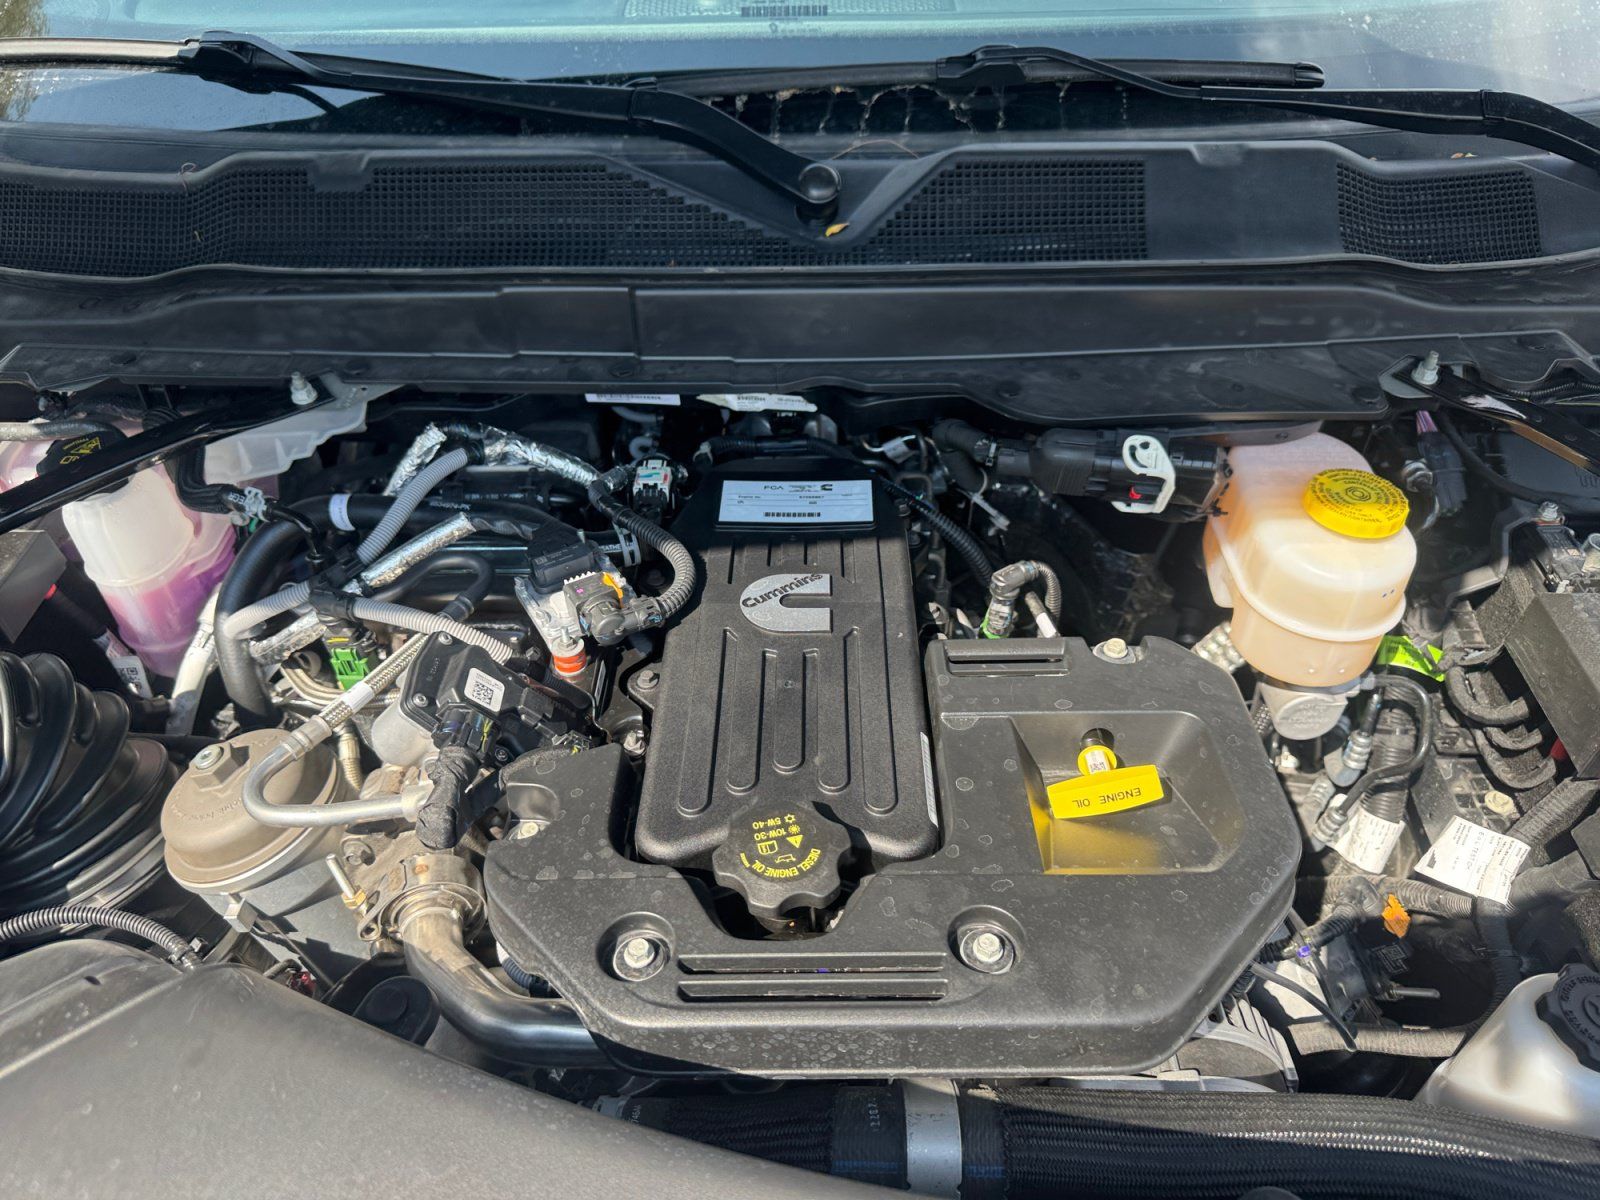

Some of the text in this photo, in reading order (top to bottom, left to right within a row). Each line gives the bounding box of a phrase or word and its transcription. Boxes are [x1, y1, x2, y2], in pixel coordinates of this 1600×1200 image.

[742, 573, 823, 608] Cummins
[1072, 787, 1142, 808] ENGINE OIL
[751, 817, 781, 829] 5W-40
[754, 828, 786, 841] 10W-30
[751, 860, 766, 874] OIL
[797, 848, 821, 872] DIESEL
[764, 866, 799, 878] ENGINE
